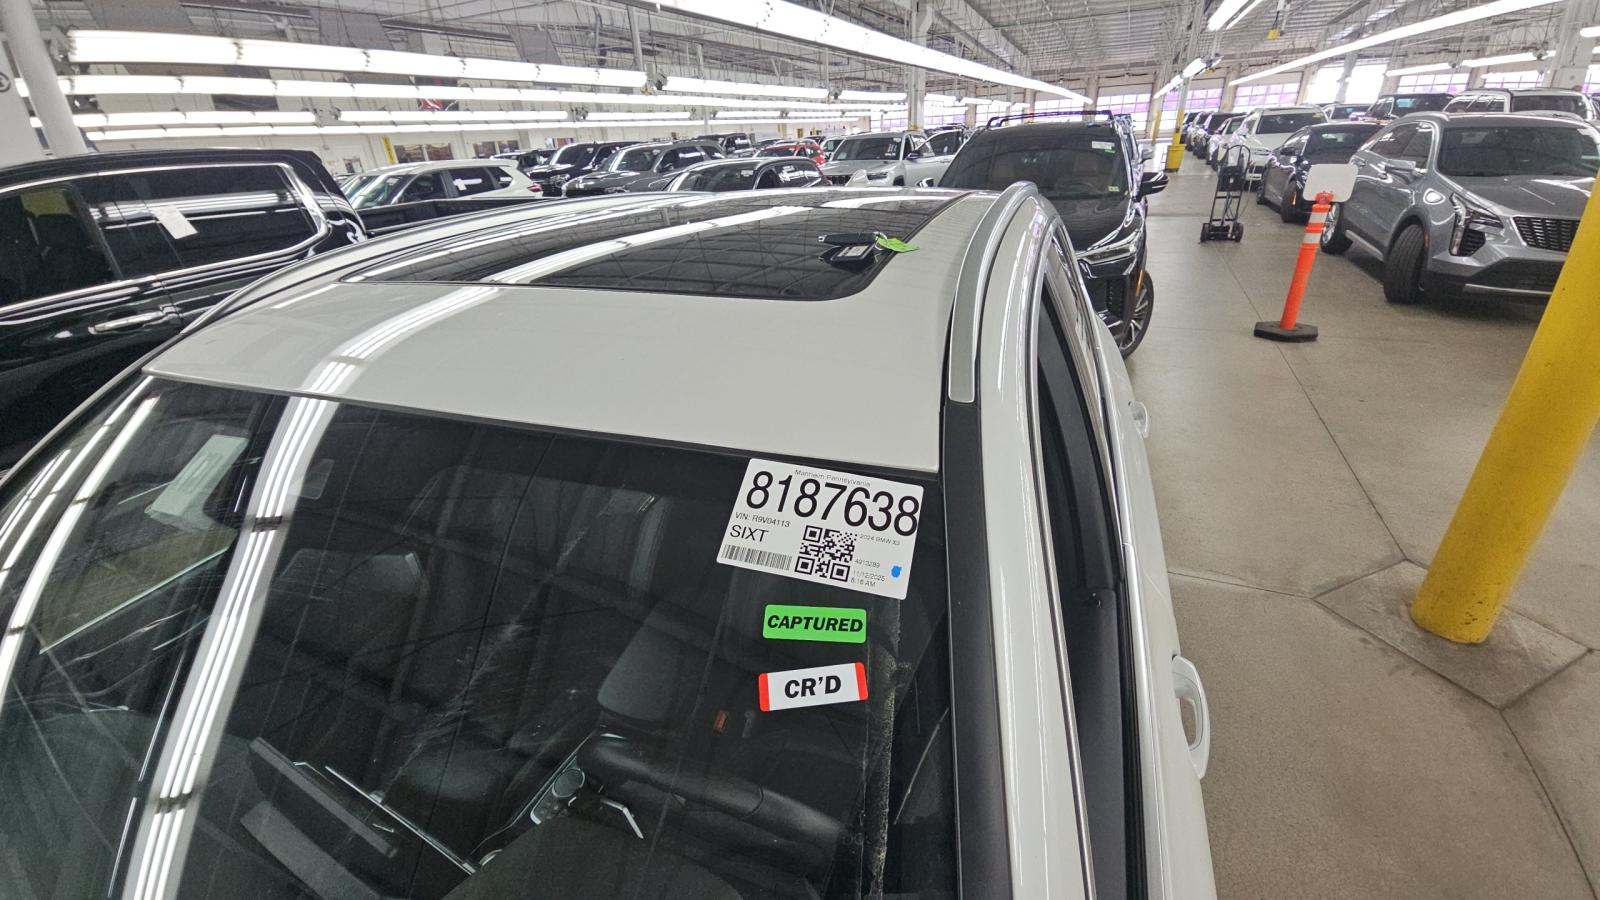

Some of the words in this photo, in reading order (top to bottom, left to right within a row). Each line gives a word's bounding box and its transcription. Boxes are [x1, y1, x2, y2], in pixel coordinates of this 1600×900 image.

[827, 473, 870, 488] Pennsylvania
[746, 471, 919, 536] 8187638
[735, 512, 750, 522] VIN:
[730, 524, 769, 543] SIXT
[768, 614, 863, 632] CAPTURED
[784, 675, 842, 698] CR'D
